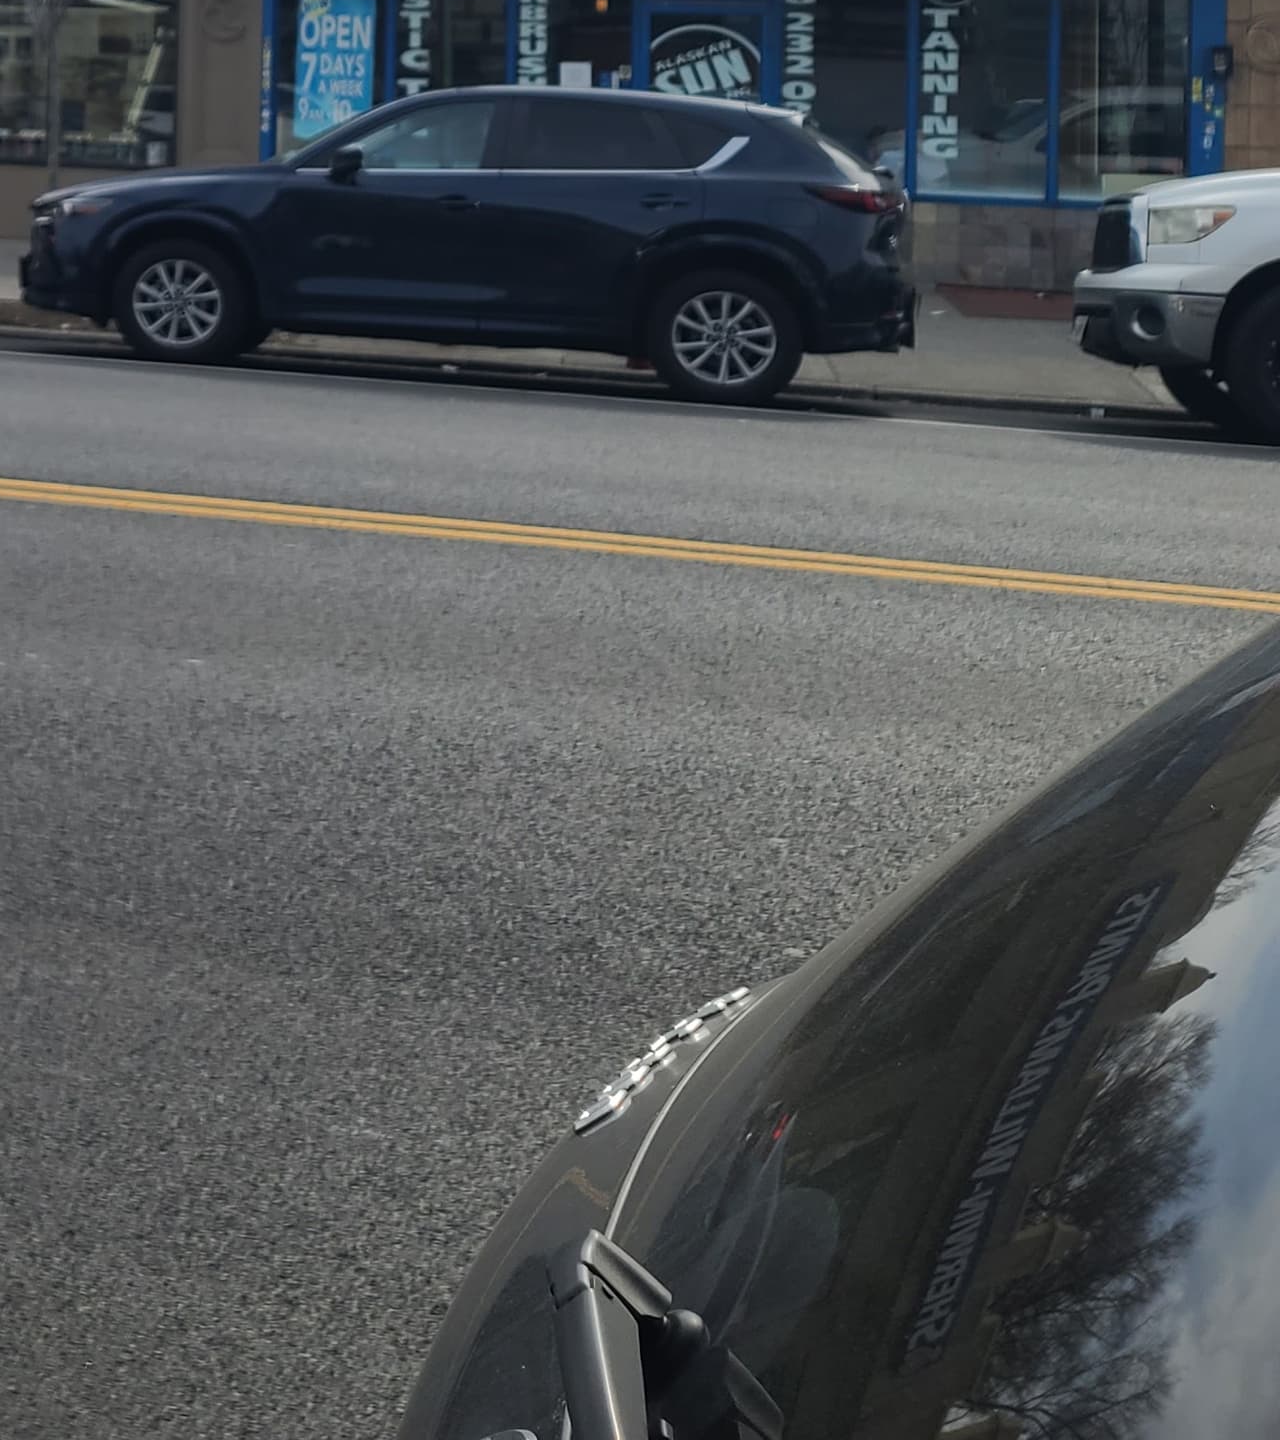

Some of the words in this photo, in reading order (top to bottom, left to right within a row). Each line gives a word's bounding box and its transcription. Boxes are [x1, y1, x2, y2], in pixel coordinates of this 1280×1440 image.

[300, 14, 372, 50] OPEN
[300, 53, 317, 93] 7
[319, 53, 366, 77] DAYS
[330, 79, 364, 96] WEEK
[654, 47, 753, 95] SUN
[921, 8, 960, 159] TANNING
